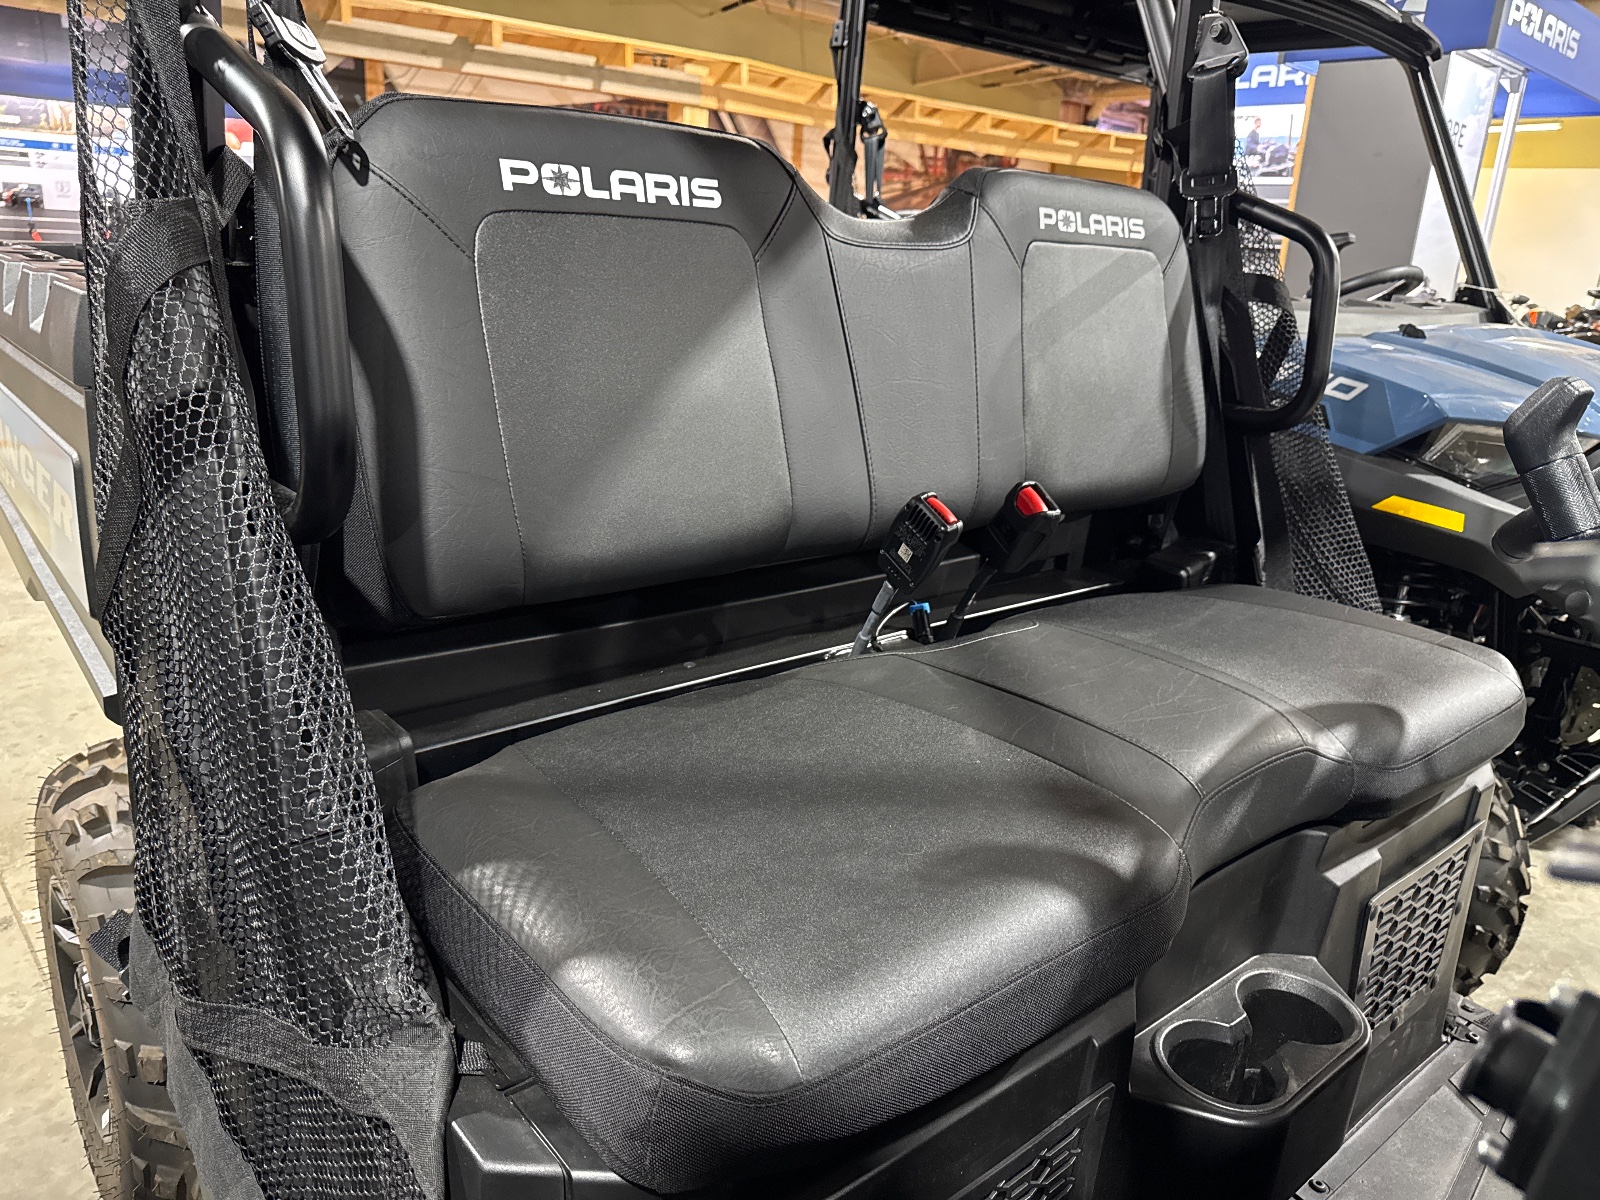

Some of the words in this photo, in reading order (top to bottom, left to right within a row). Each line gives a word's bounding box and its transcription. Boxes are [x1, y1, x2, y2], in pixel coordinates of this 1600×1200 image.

[1507, 0, 1581, 60] POLARIS
[498, 158, 722, 209] POLARIS
[1038, 206, 1146, 240] POLARIS
[0, 416, 74, 542] NGER
